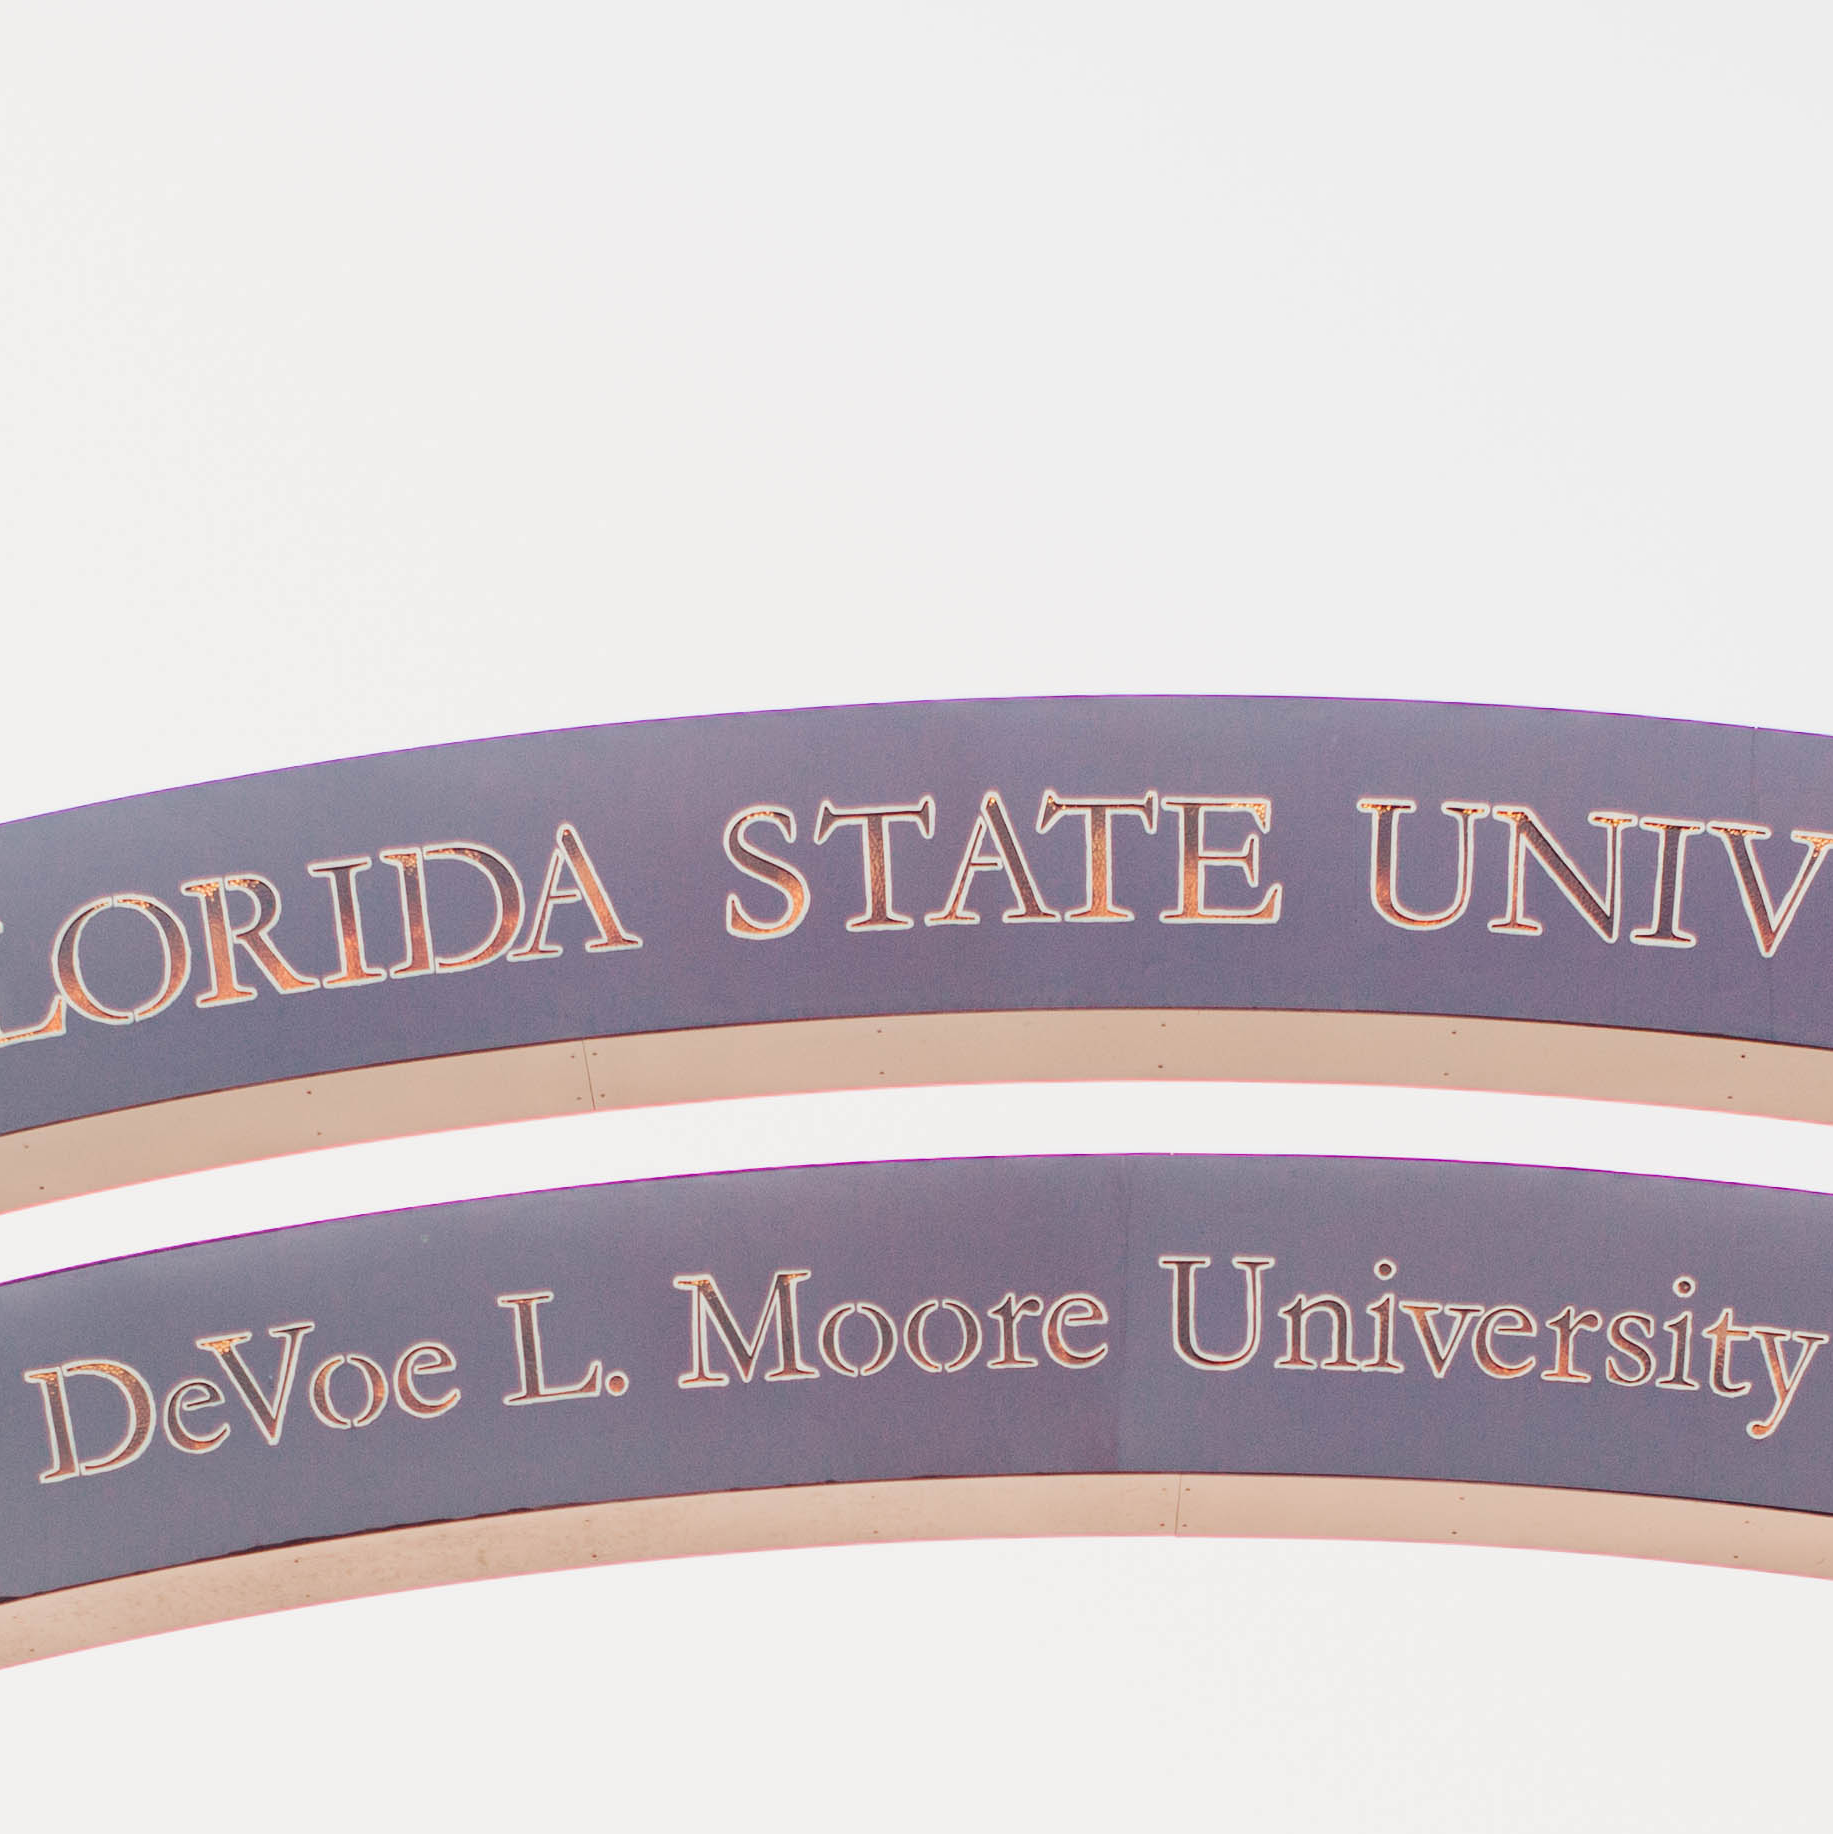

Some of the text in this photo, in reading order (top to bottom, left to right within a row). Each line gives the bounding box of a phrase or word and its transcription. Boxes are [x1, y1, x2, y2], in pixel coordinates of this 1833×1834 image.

[722, 789, 1283, 940] STATE
[24, 1322, 461, 1484] DeVoe
[497, 1291, 629, 1406] L.
[673, 1270, 1109, 1389] Moore
[1158, 1256, 1829, 1440] University
